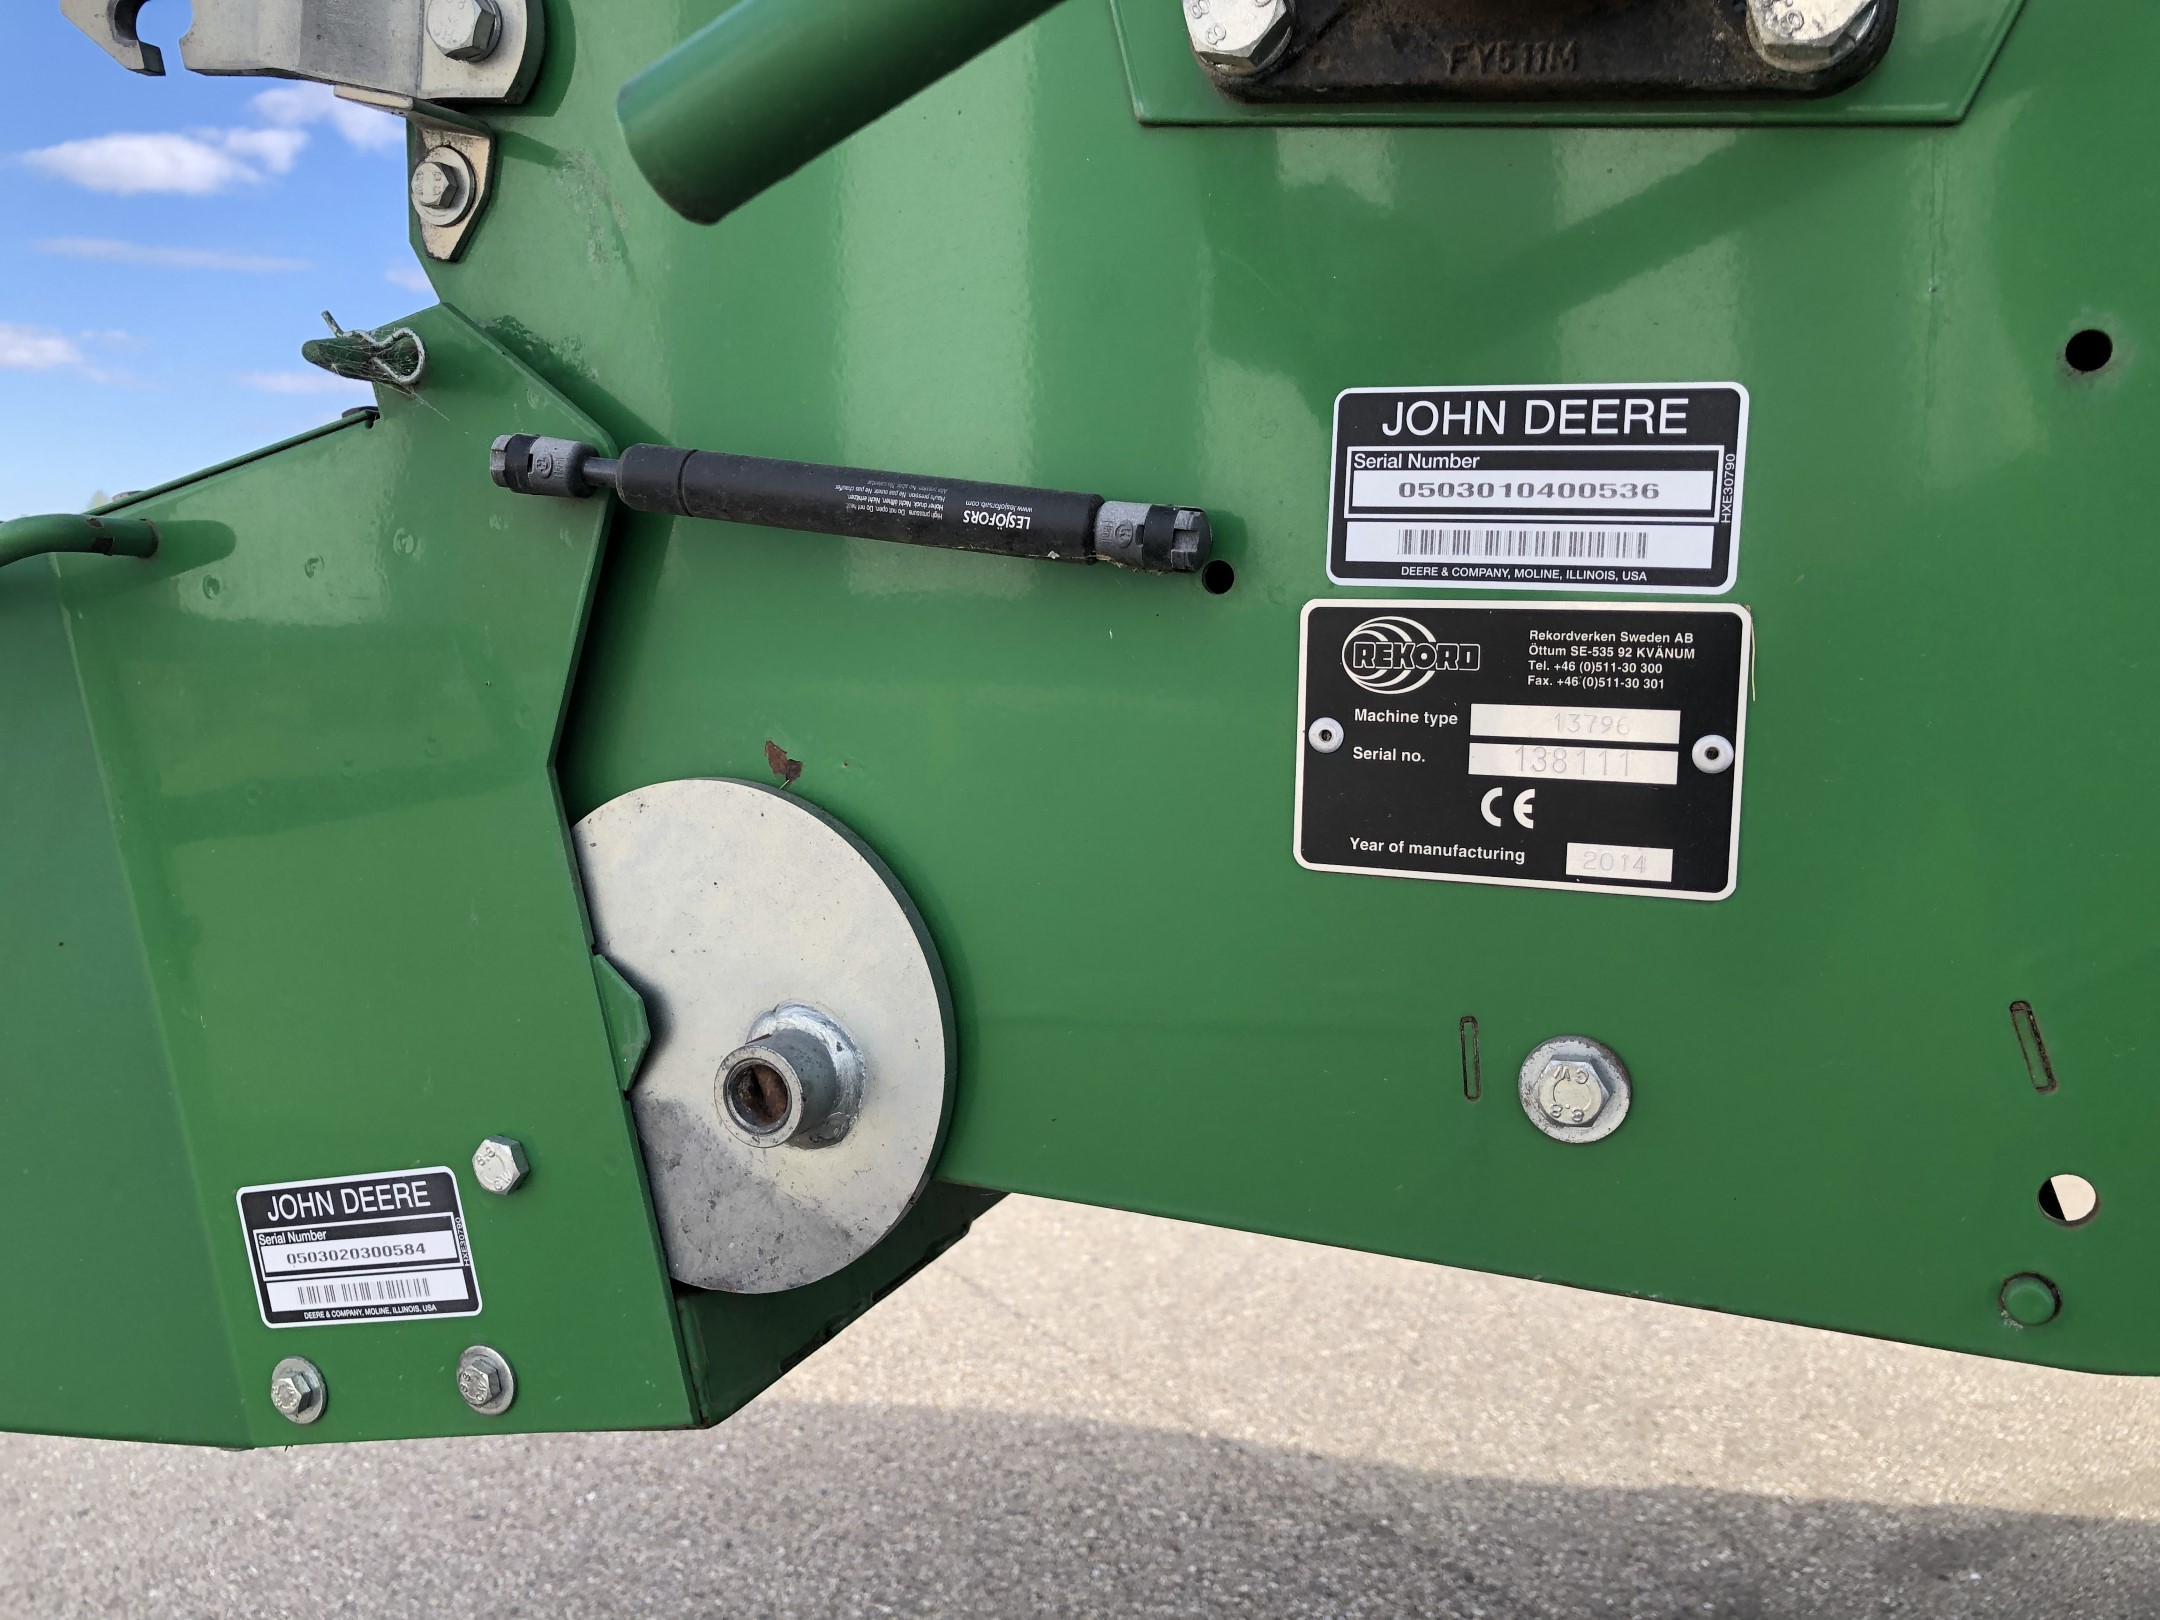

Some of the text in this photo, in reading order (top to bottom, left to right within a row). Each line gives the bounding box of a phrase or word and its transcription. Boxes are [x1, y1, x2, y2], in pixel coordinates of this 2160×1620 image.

[1382, 398, 1689, 437] JOHN DEERE
[1353, 453, 1480, 469] Serial Number
[1398, 482, 1660, 500] 0503010400536
[1721, 453, 1736, 524] HXE30790
[963, 510, 1031, 530] LESJÖFORS
[1401, 566, 1647, 582] DEERE & COMPANY, MOLINE, ILLINOIS, USA
[1529, 630, 1694, 644] Rekordverken Sweden AB
[1353, 641, 1481, 671] REKORD
[1528, 643, 1695, 659] Öttum SE-535 92 KVÄNUM
[1528, 660, 1662, 674] Tel. +46 (0)511-30 300
[1527, 675, 1664, 690] Fax. +46 (0)511-30 301
[1354, 708, 1458, 727] Machine type
[1554, 712, 1631, 736] 13796
[1352, 746, 1426, 763] Serial no.
[1514, 745, 1630, 777] 138111
[1480, 786, 1536, 829] CE
[1349, 837, 1526, 865] Year of manufacturing
[1582, 850, 1647, 873] 2014
[267, 1180, 432, 1222] JOHN DEERE
[258, 1229, 327, 1246] Serial Number
[286, 1242, 426, 1265] 0503020300584
[304, 1304, 437, 1320] DEERE & COMPANY, MOLINE, ILLINOIS, USA
